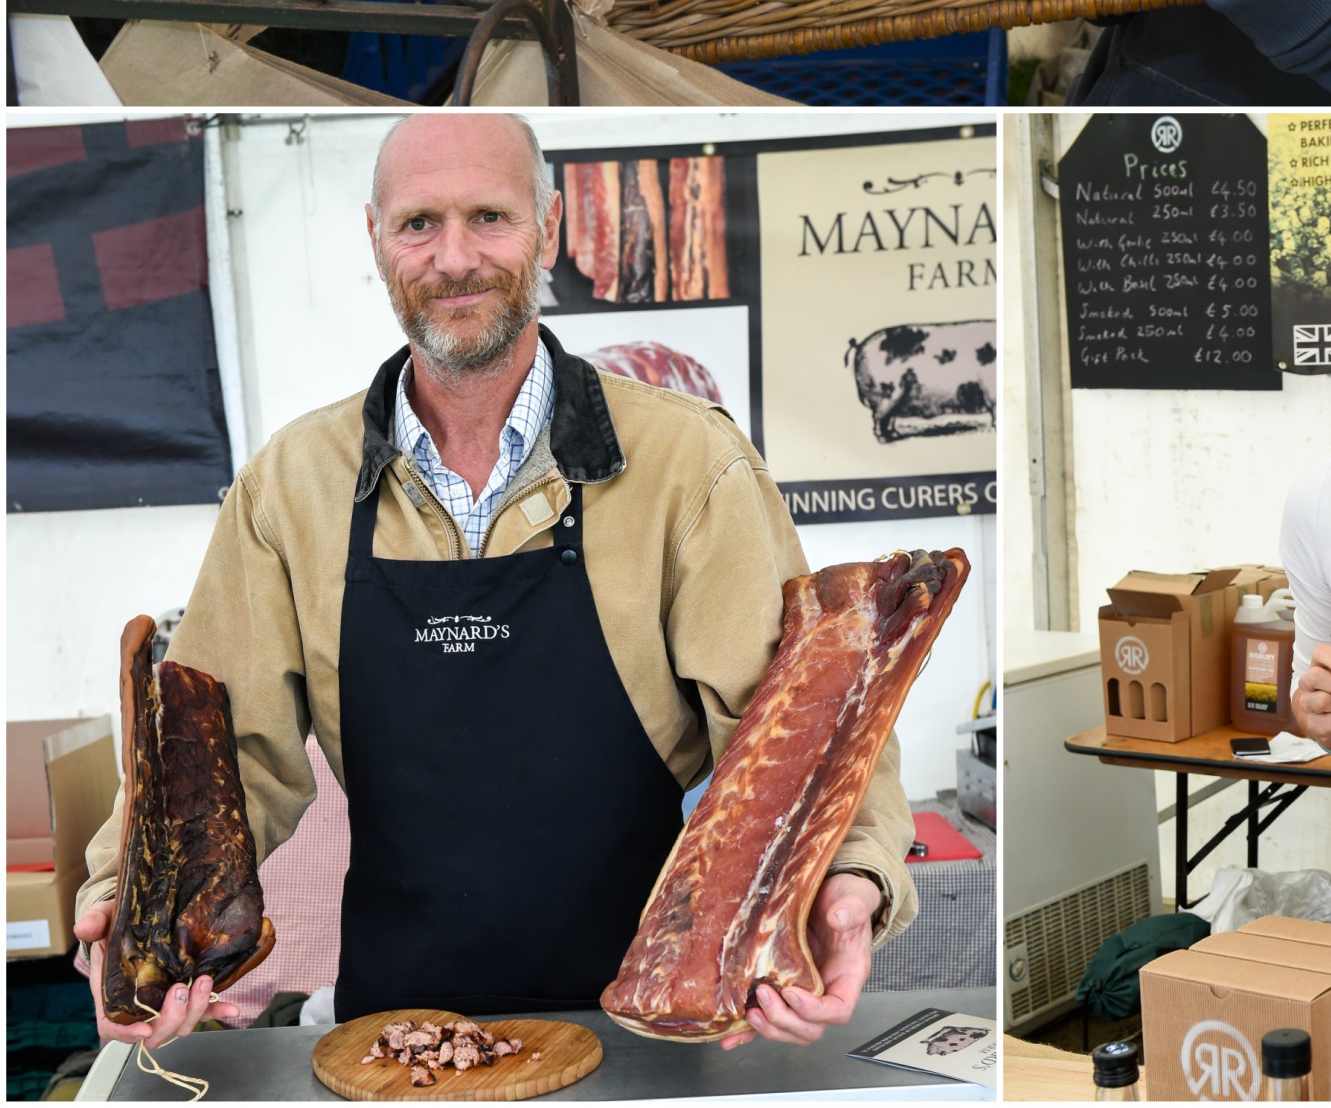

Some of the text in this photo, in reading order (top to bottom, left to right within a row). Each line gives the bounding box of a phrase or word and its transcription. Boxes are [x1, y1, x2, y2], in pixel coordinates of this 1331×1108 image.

[1124, 153, 1187, 180] Prices
[1301, 155, 1329, 168] RICH
[1075, 180, 1257, 202] Natural 500ml £4.50
[1076, 204, 1257, 226] Natural 250ml £3.50
[1160, 231, 1198, 245] 250ml
[1077, 258, 1111, 273] With
[1166, 252, 1201, 265] 250ml
[1078, 279, 1115, 293] With
[1122, 274, 1157, 292] Basil
[1166, 274, 1200, 290] 250ml
[1080, 302, 1188, 320] Smoked 500ml
[1078, 325, 1128, 340] Smoked
[1136, 325, 1184, 338] 250ml
[1080, 346, 1252, 365] Gift Pack £12.00
[882, 483, 978, 509] CURERS
[415, 624, 510, 642] MAYNARD'S
[442, 642, 475, 653] FARM
